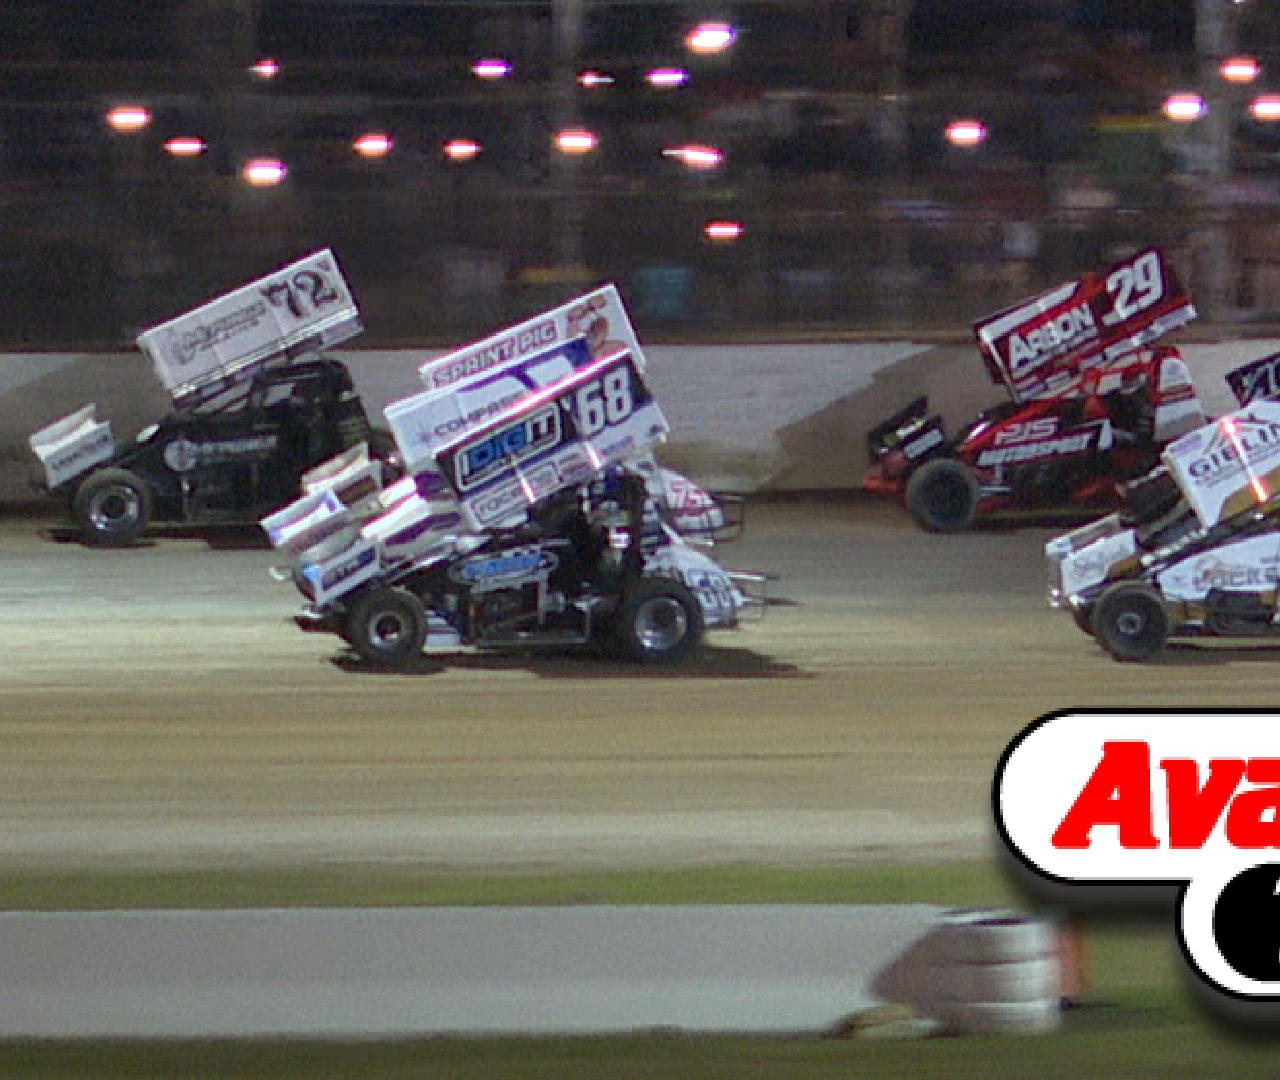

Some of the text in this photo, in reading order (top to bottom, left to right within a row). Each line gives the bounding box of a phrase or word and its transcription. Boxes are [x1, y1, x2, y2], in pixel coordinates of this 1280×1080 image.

[261, 271, 338, 319] 72
[1103, 250, 1160, 326] 29
[432, 319, 557, 389] SPRINT PIG
[575, 366, 635, 437] 68
